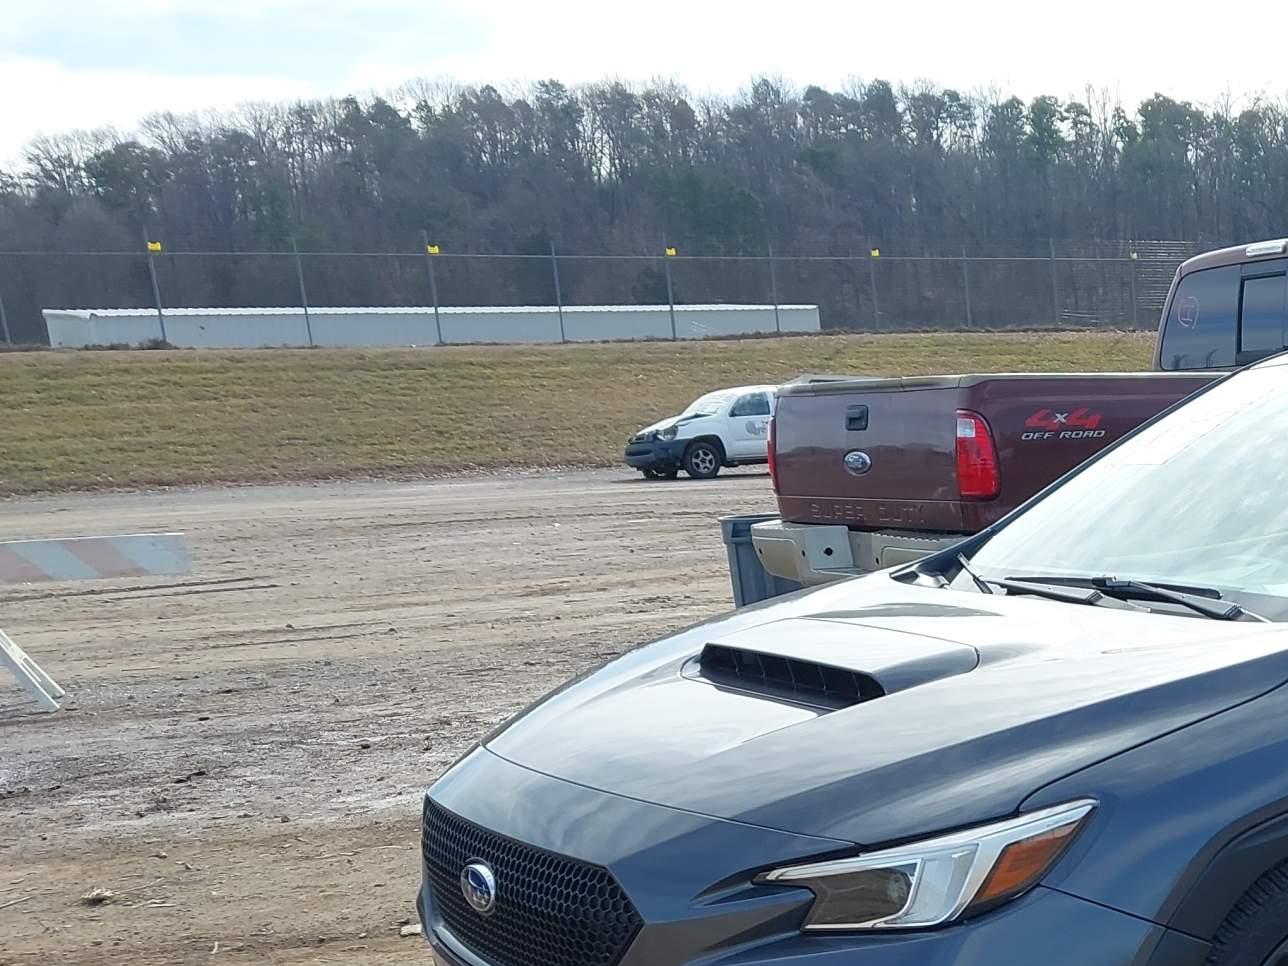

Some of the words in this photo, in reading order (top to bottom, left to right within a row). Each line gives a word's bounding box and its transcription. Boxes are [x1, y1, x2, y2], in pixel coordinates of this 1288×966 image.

[1021, 431, 1056, 440] OFF
[1059, 430, 1105, 439] ROAD
[810, 503, 866, 520] SUPER
